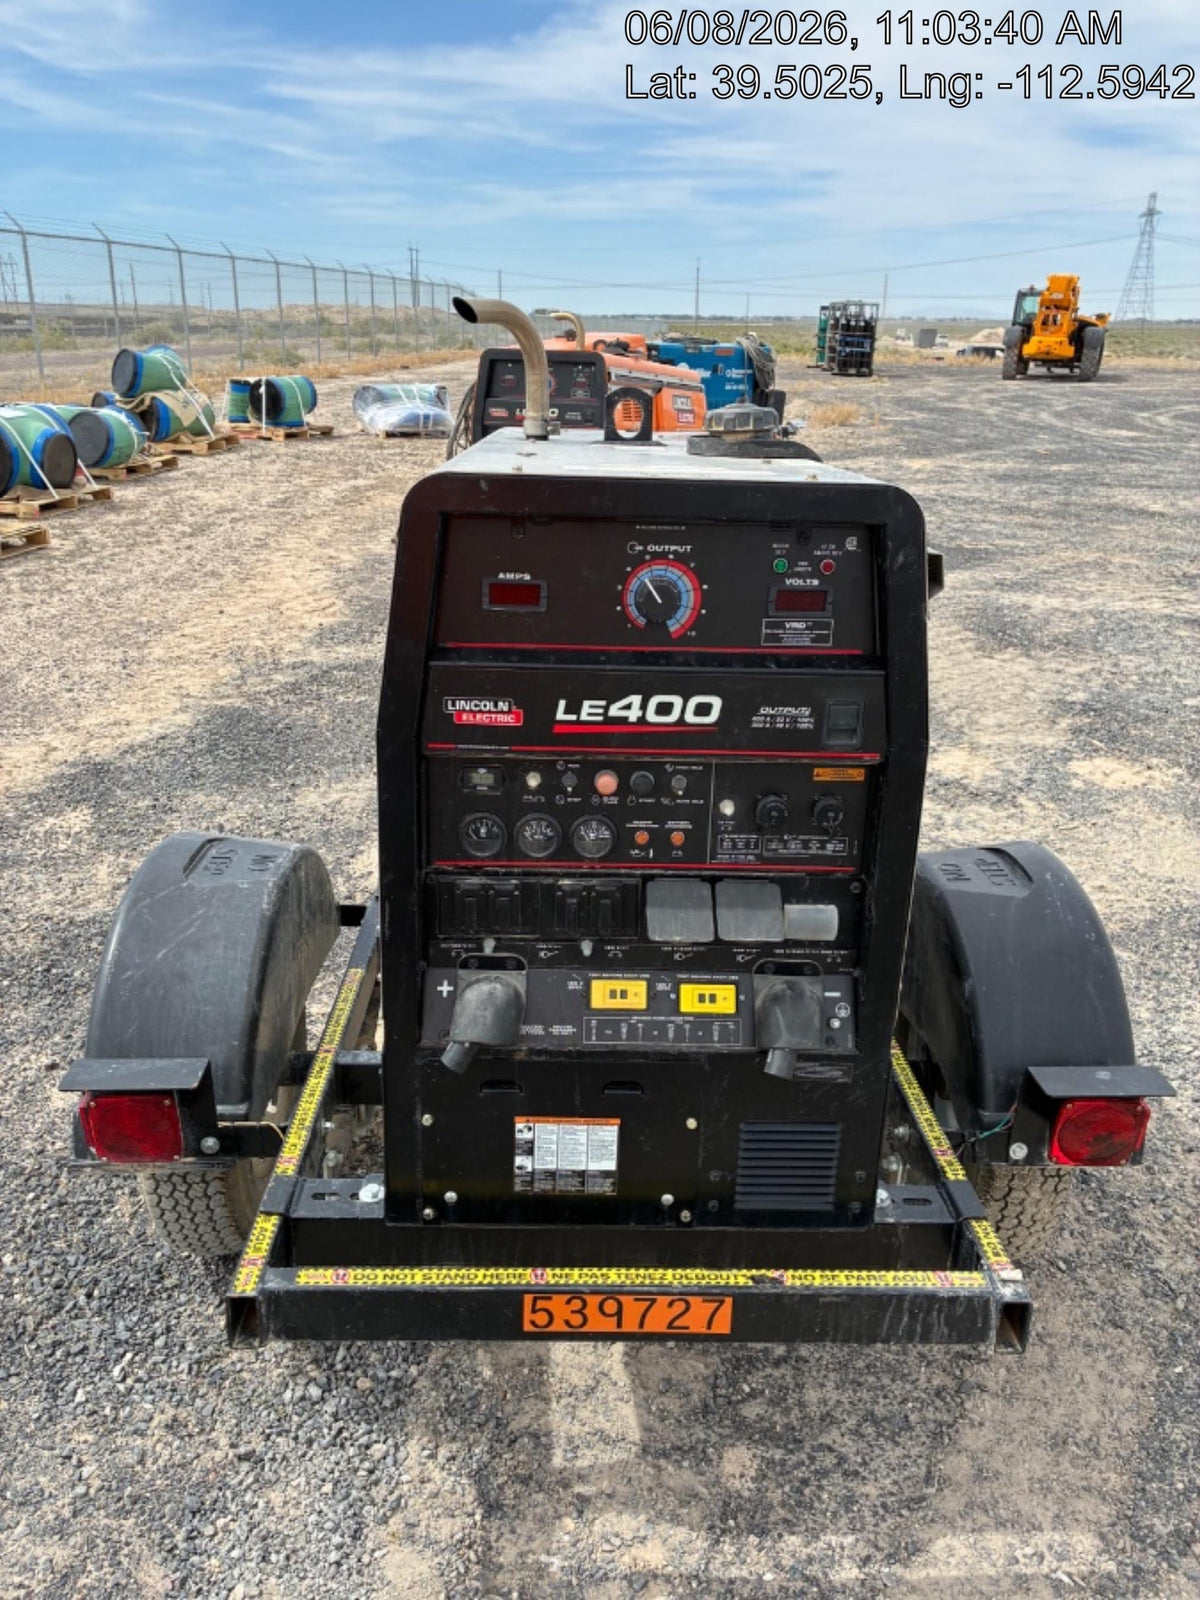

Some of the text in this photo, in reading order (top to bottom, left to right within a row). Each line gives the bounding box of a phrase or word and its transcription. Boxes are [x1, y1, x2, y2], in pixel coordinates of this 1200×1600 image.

[647, 545, 693, 553] OUTPUT
[498, 572, 531, 580] AMPS
[785, 578, 820, 586] VOLTS
[447, 699, 510, 712] LINCOLN
[555, 694, 723, 724] LE400
[461, 713, 516, 723] ELECTRIC
[940, 863, 972, 882] NO
[353, 1271, 528, 1282] DO NOT STAND HERE
[551, 1271, 575, 1281] NE
[578, 1272, 612, 1281] PAS
[616, 1272, 669, 1281] TENEZ
[672, 1272, 739, 1282] DEBOUT
[790, 1274, 816, 1282] NO
[821, 1274, 840, 1282] SE
[844, 1274, 886, 1283] PARE
[529, 1295, 726, 1331] 539727
